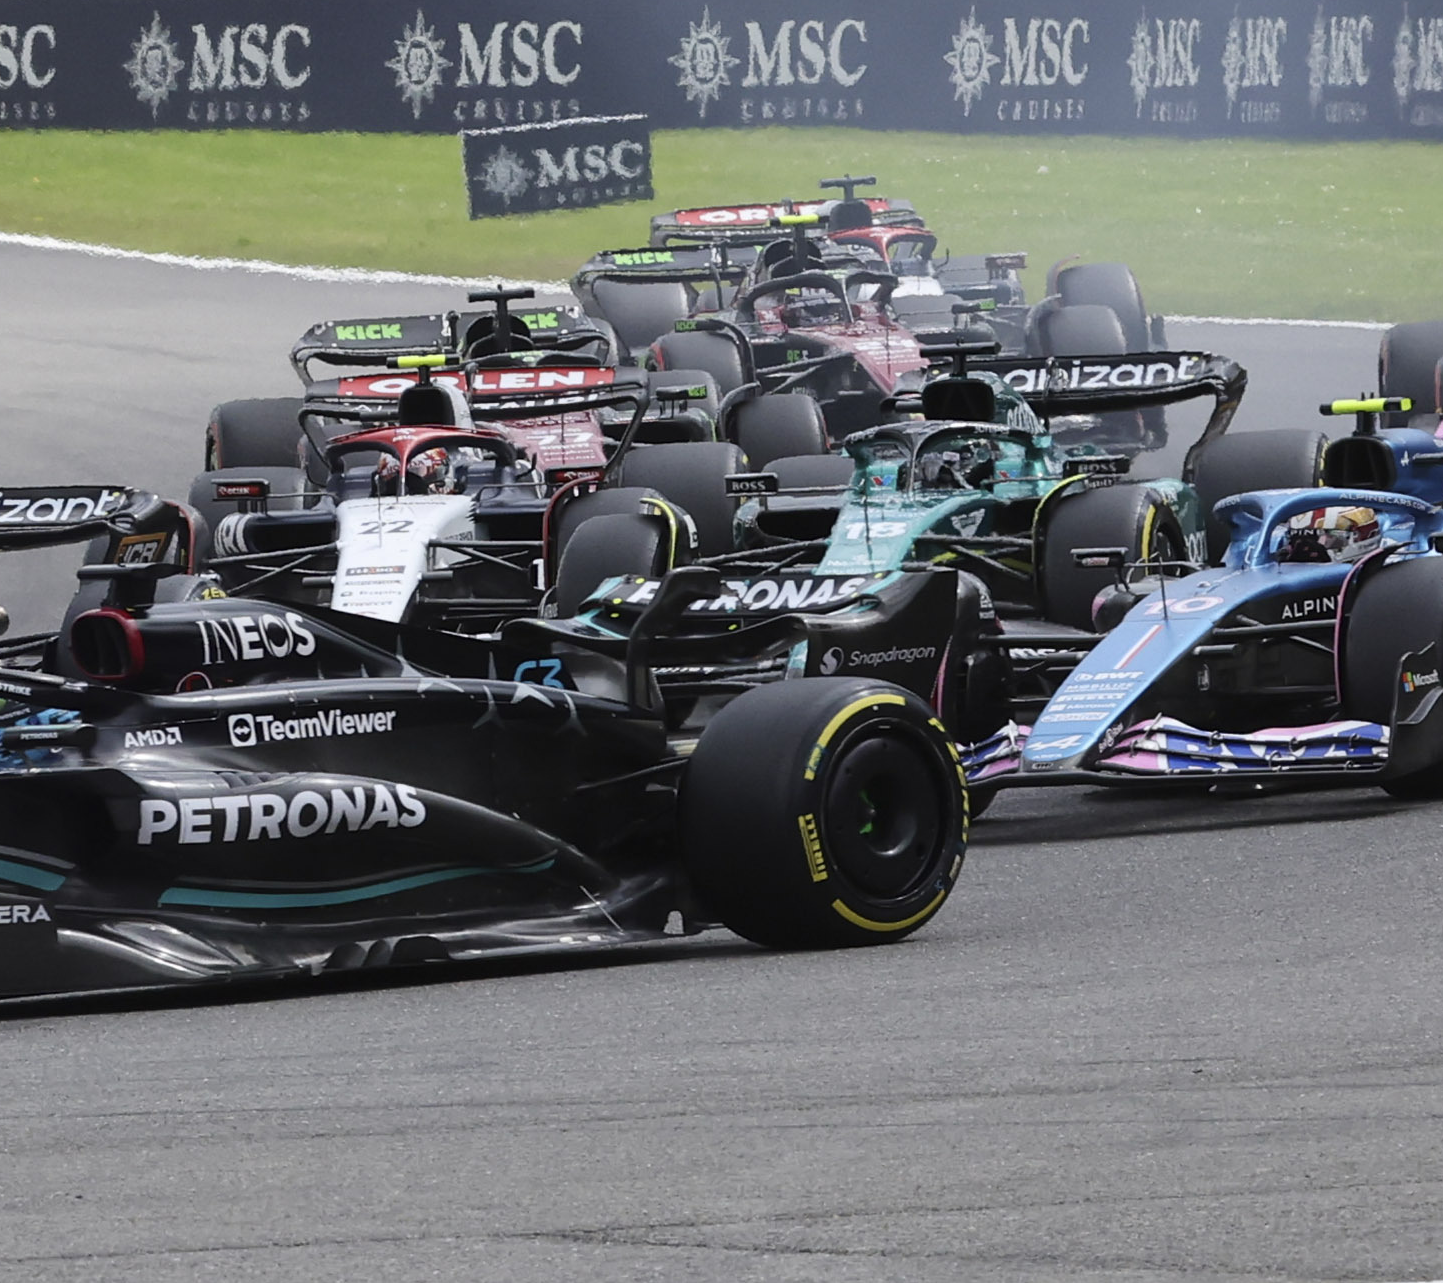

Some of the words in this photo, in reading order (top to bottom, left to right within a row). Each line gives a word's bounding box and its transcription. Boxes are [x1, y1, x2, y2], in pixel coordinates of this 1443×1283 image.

[189, 24, 311, 90] MSC
[455, 22, 581, 87] MSC
[742, 19, 867, 88] MSC
[1000, 18, 1088, 87] MSC
[534, 140, 644, 187] MSC
[336, 322, 403, 340] KICK
[732, 480, 766, 491] BOSS
[358, 520, 415, 535] 22
[842, 520, 908, 541] 18
[1144, 596, 1225, 615] 10
[1281, 596, 1336, 619] ALPIN
[197, 612, 316, 665] INEOS
[848, 644, 937, 667] Snapdragon
[124, 730, 166, 749] AMD
[257, 709, 397, 742] TeamViewer
[137, 783, 427, 845] PETRONAS
